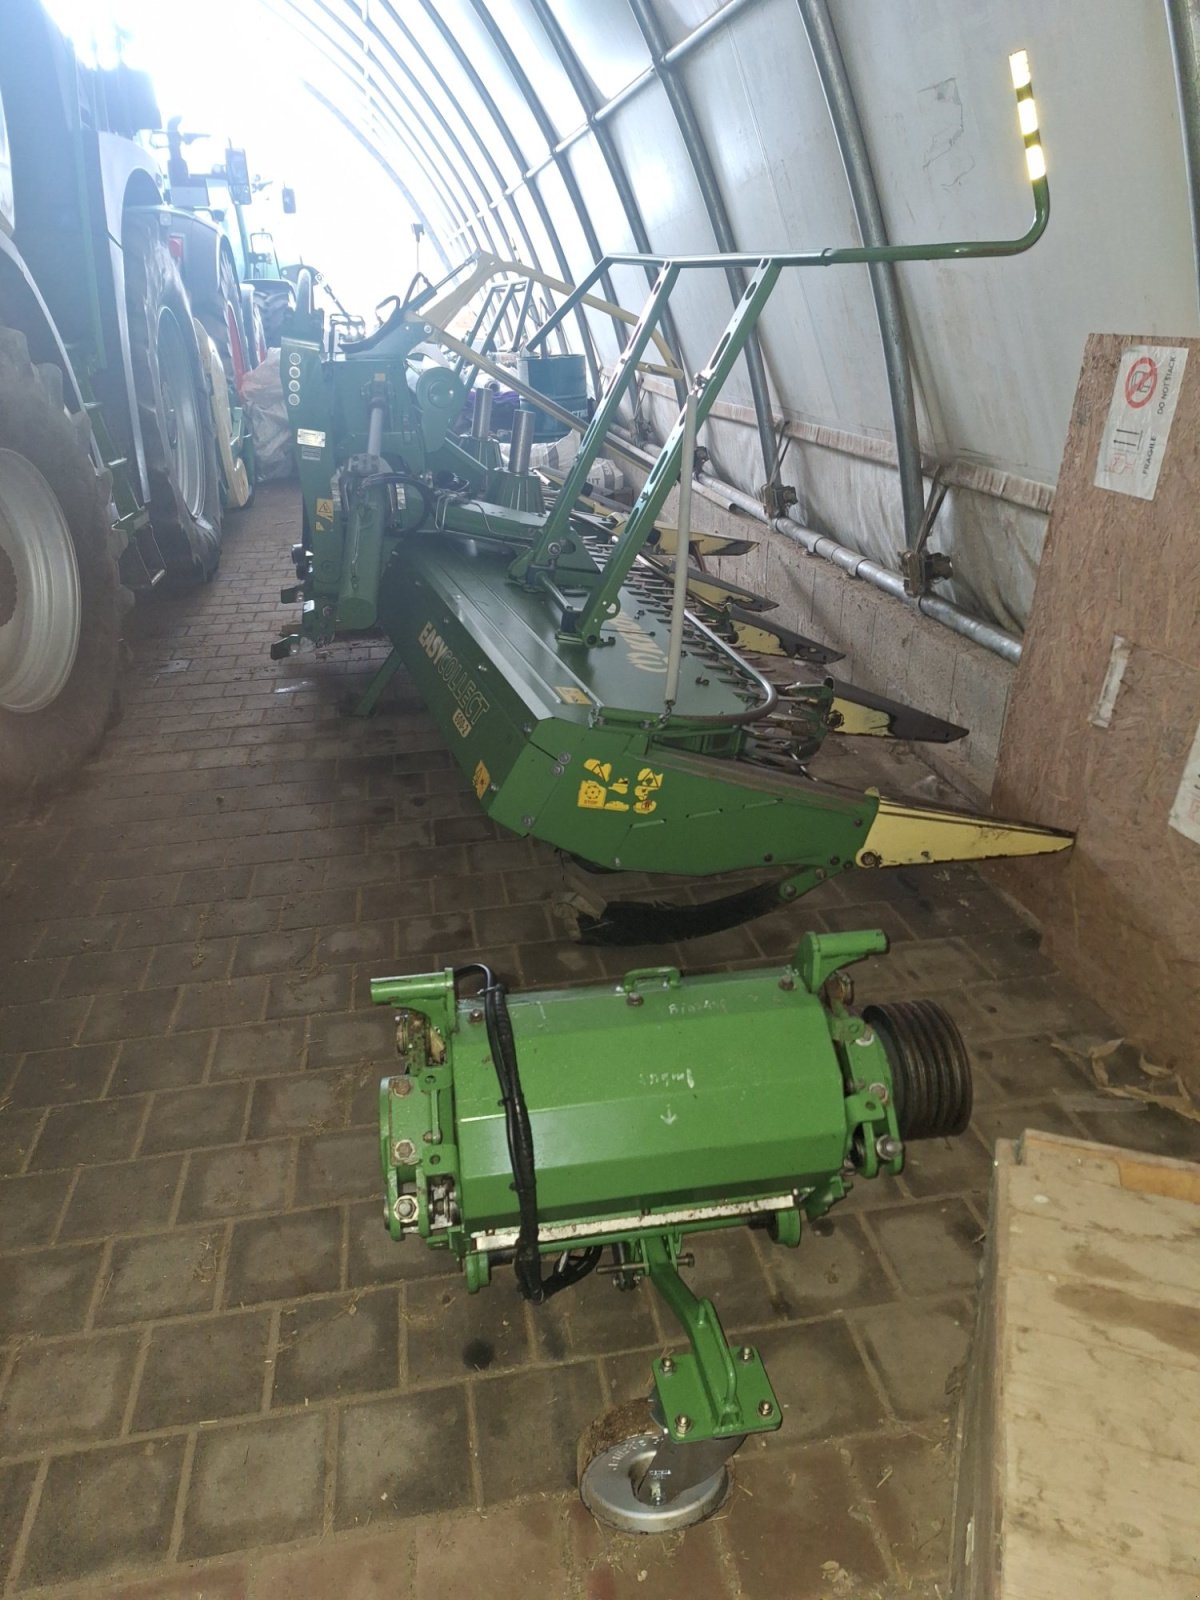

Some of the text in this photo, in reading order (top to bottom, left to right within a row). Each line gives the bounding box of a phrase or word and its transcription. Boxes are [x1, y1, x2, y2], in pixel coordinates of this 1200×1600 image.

[1157, 355, 1176, 415] DO NOT STACK
[1142, 436, 1157, 475] FRAGILE
